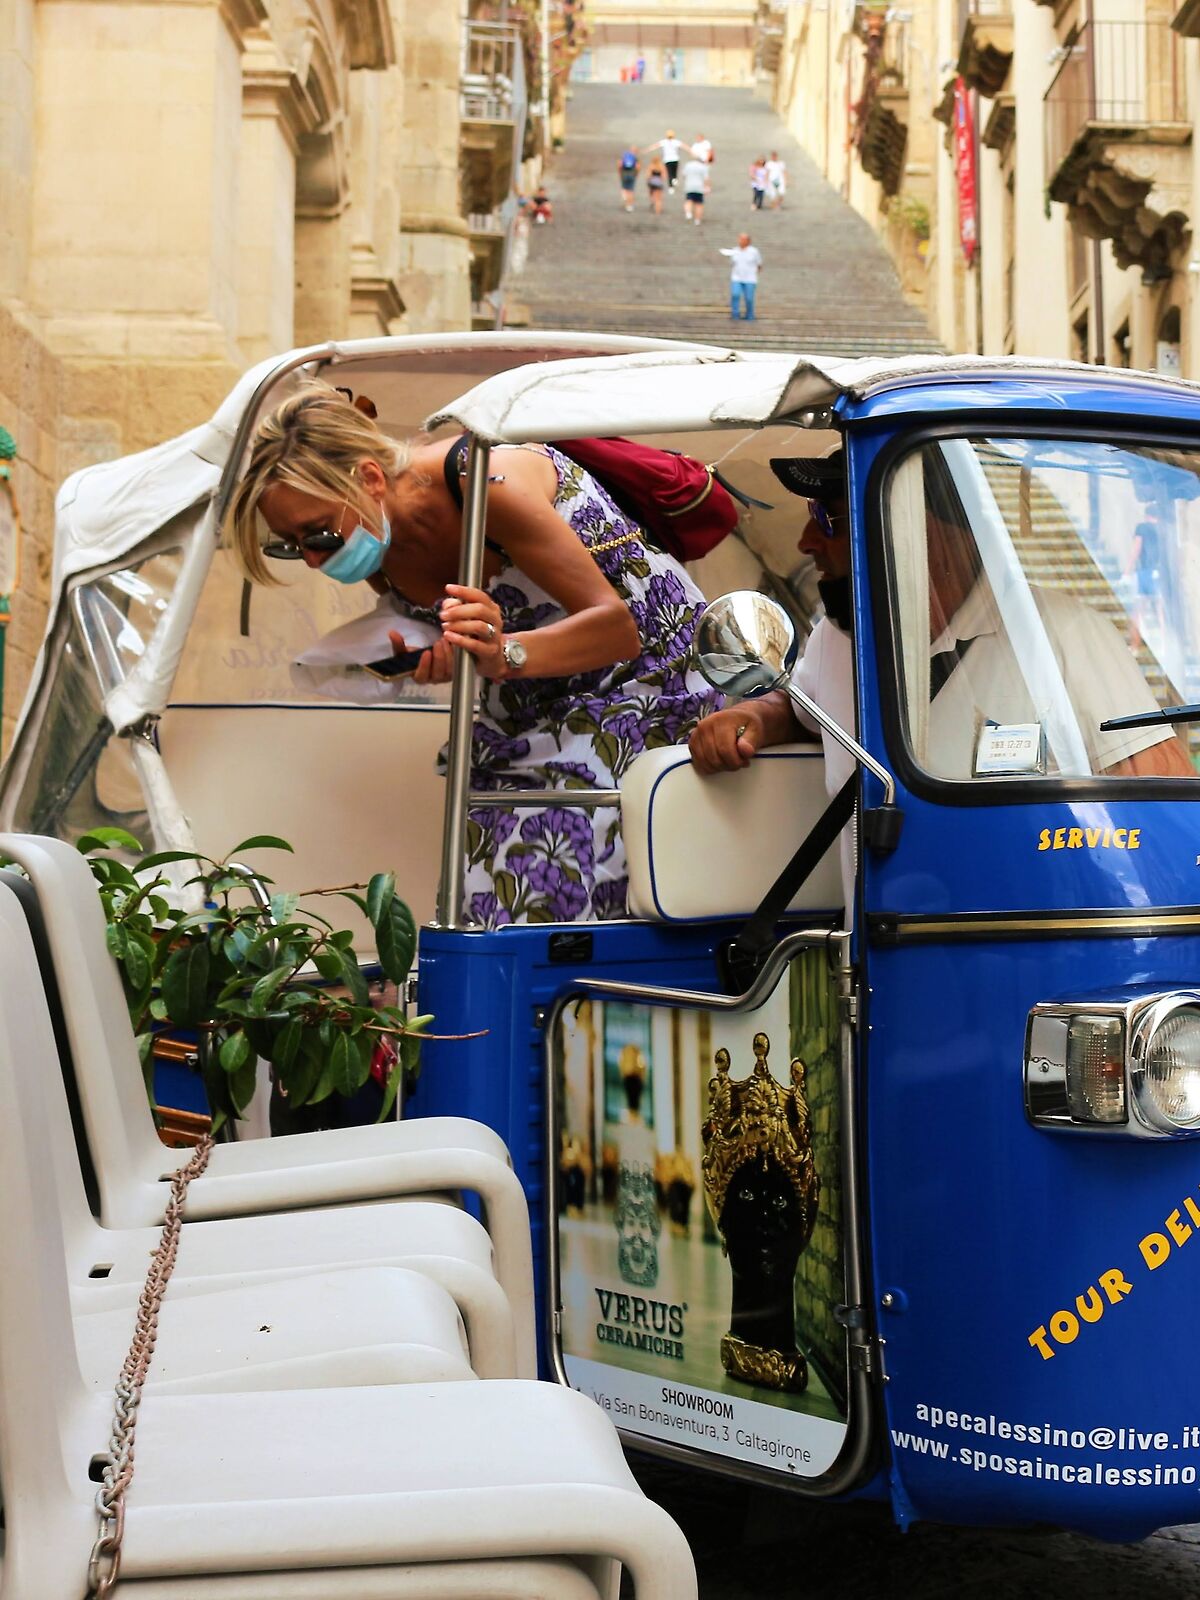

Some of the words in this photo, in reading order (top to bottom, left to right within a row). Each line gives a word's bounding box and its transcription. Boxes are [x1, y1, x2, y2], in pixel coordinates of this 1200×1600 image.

[1038, 827, 1141, 851] SERVICE
[595, 1287, 685, 1338] VERUS
[1028, 1268, 1134, 1361] TOUR
[596, 1323, 685, 1360] CERAMICHE
[593, 1391, 611, 1410] Via
[614, 1397, 636, 1417] San
[639, 1403, 719, 1442] Bonaventura,
[722, 1425, 730, 1442] 3
[735, 1428, 811, 1463] Caltagirone
[662, 1387, 734, 1420] SHOWROOM
[916, 1403, 1200, 1450] apecalessino@live.it
